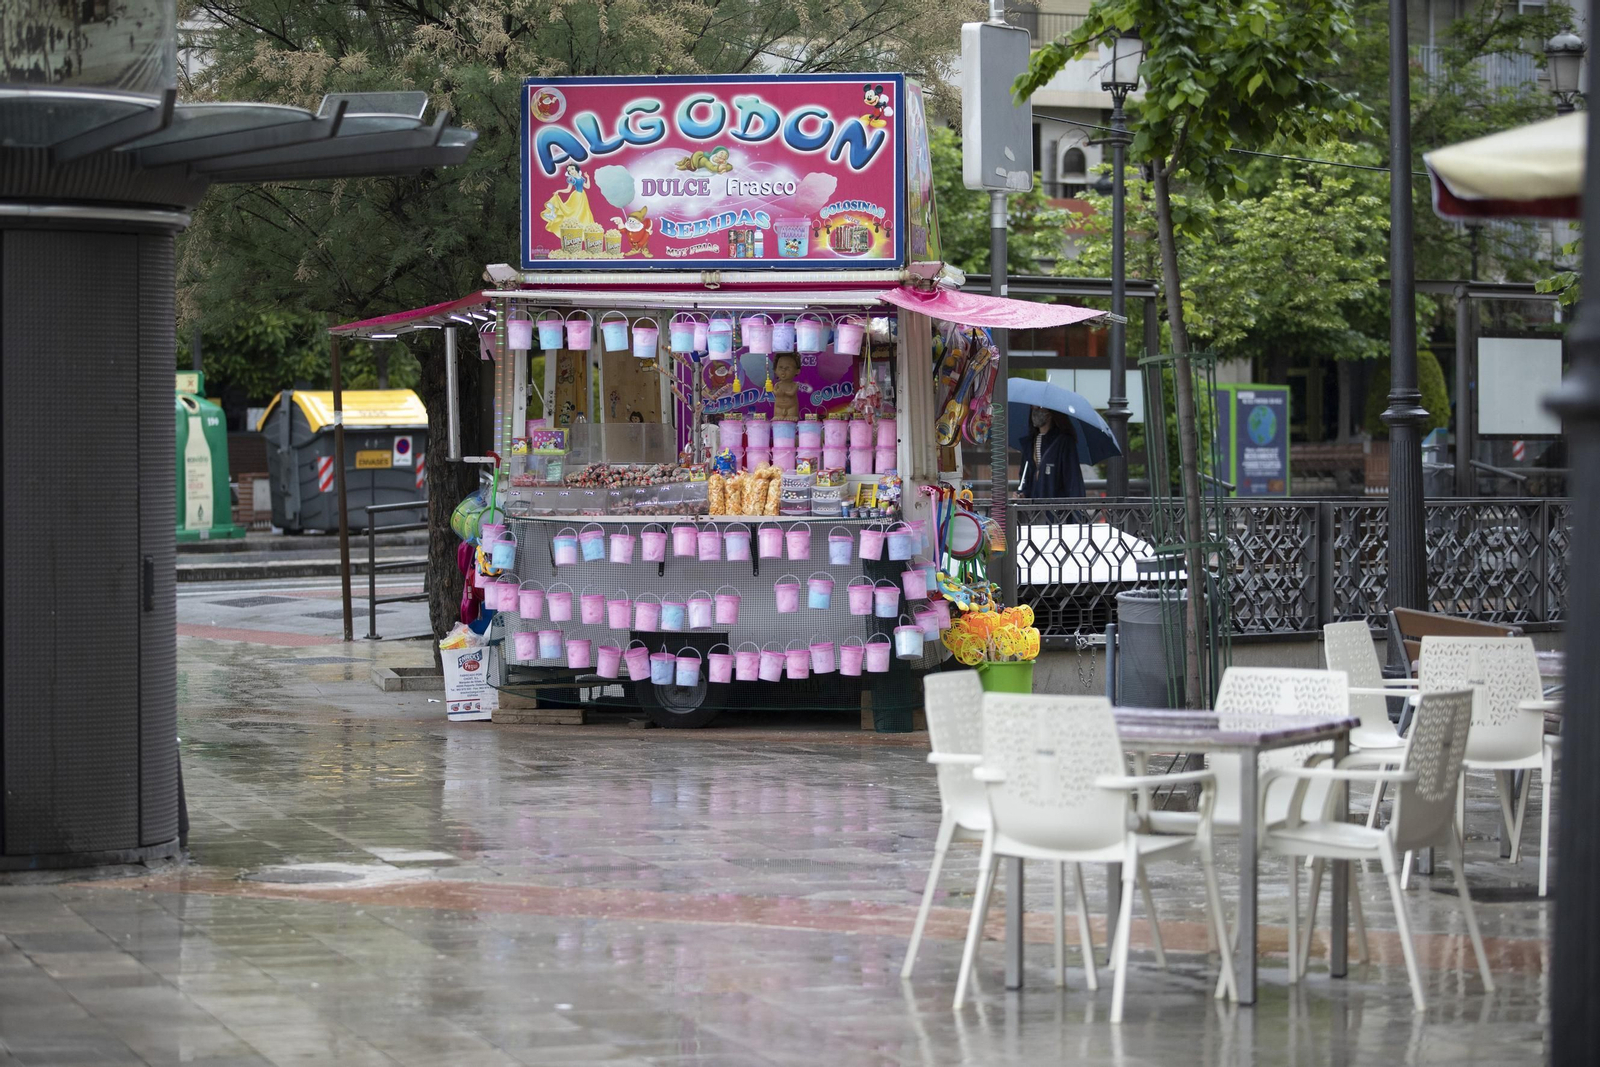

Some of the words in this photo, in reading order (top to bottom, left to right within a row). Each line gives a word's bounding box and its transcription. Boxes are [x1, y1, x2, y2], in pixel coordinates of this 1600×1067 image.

[535, 92, 886, 175] ALGODON
[641, 178, 711, 197] DULCE
[726, 177, 797, 196] Frasco
[820, 200, 886, 219] GOLOSINAS
[660, 208, 771, 239] BEBIDAS
